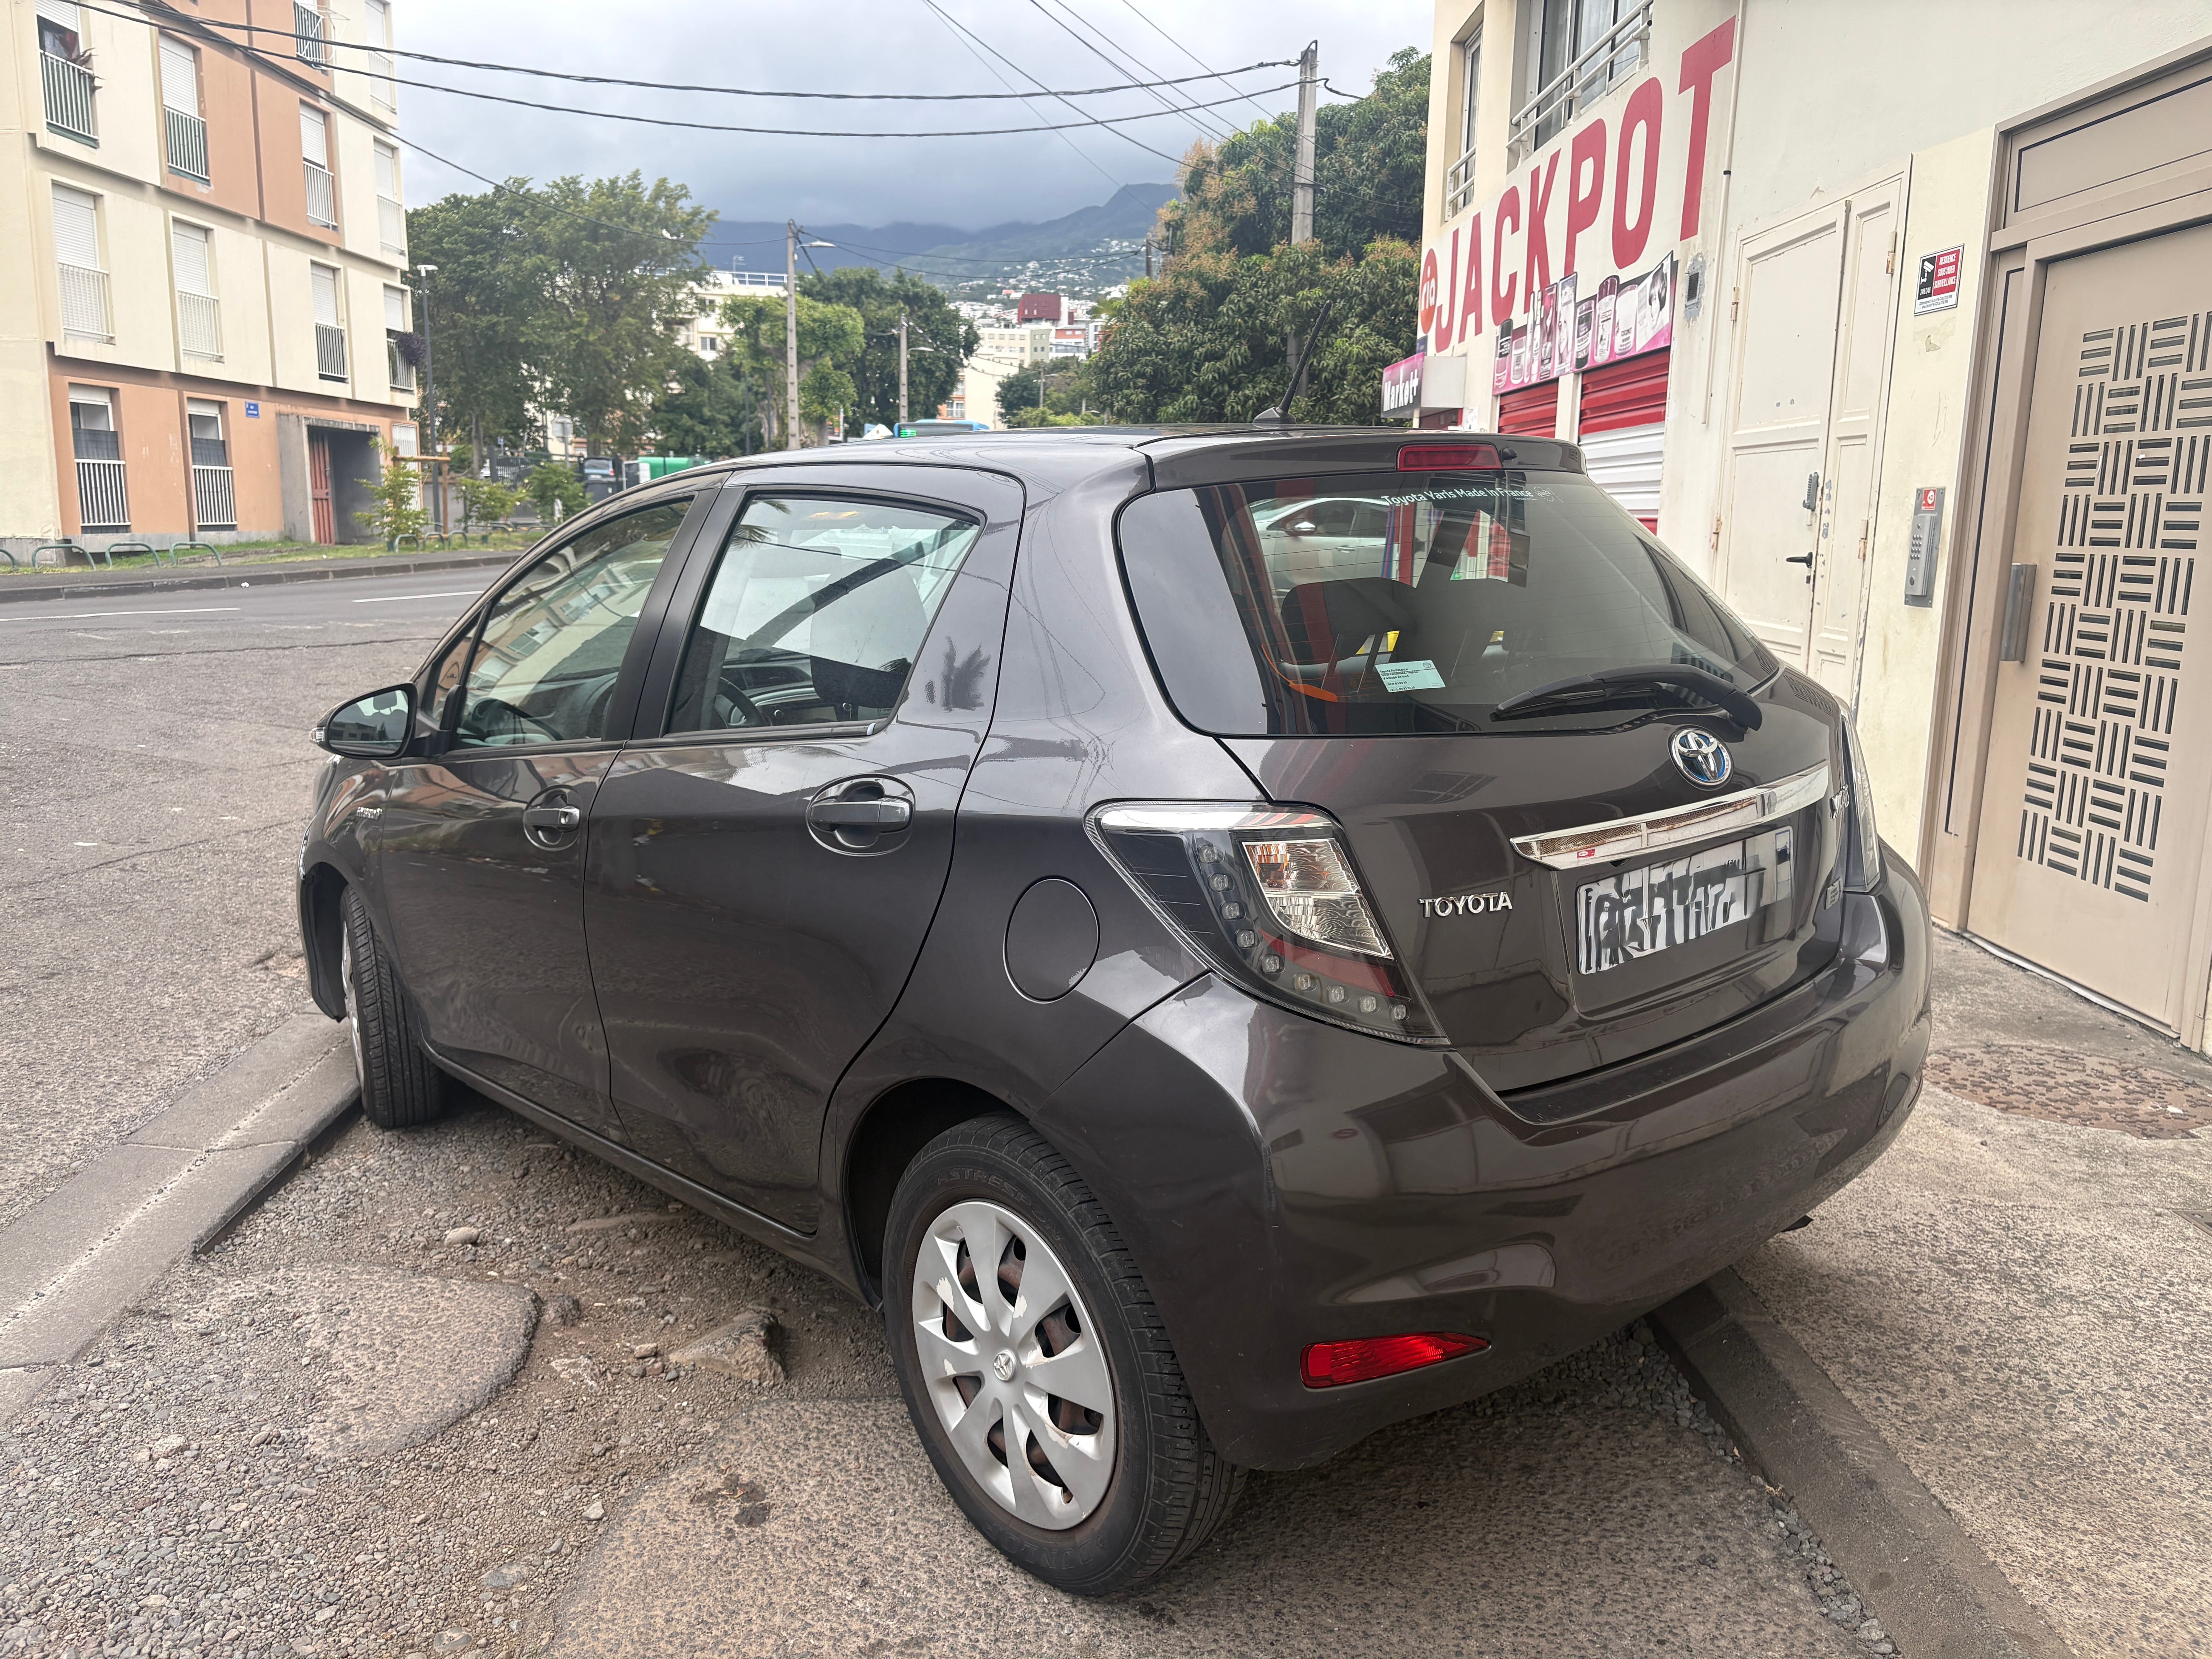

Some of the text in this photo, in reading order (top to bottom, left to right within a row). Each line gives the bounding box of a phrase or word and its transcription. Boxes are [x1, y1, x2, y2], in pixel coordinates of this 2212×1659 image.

[1435, 15, 1736, 353] JACKPOT
[1939, 253, 1956, 265] RESIDENCE
[1937, 264, 1956, 277] SOUS VIDEO
[1421, 266, 1436, 311] ria
[1934, 275, 1956, 289] SURVEILLANCE
[1381, 488, 1534, 505] Toyota Yaris Made in France
[1419, 891, 1513, 918] TOYOTA
[927, 1167, 1085, 1281] FASTRESPON
